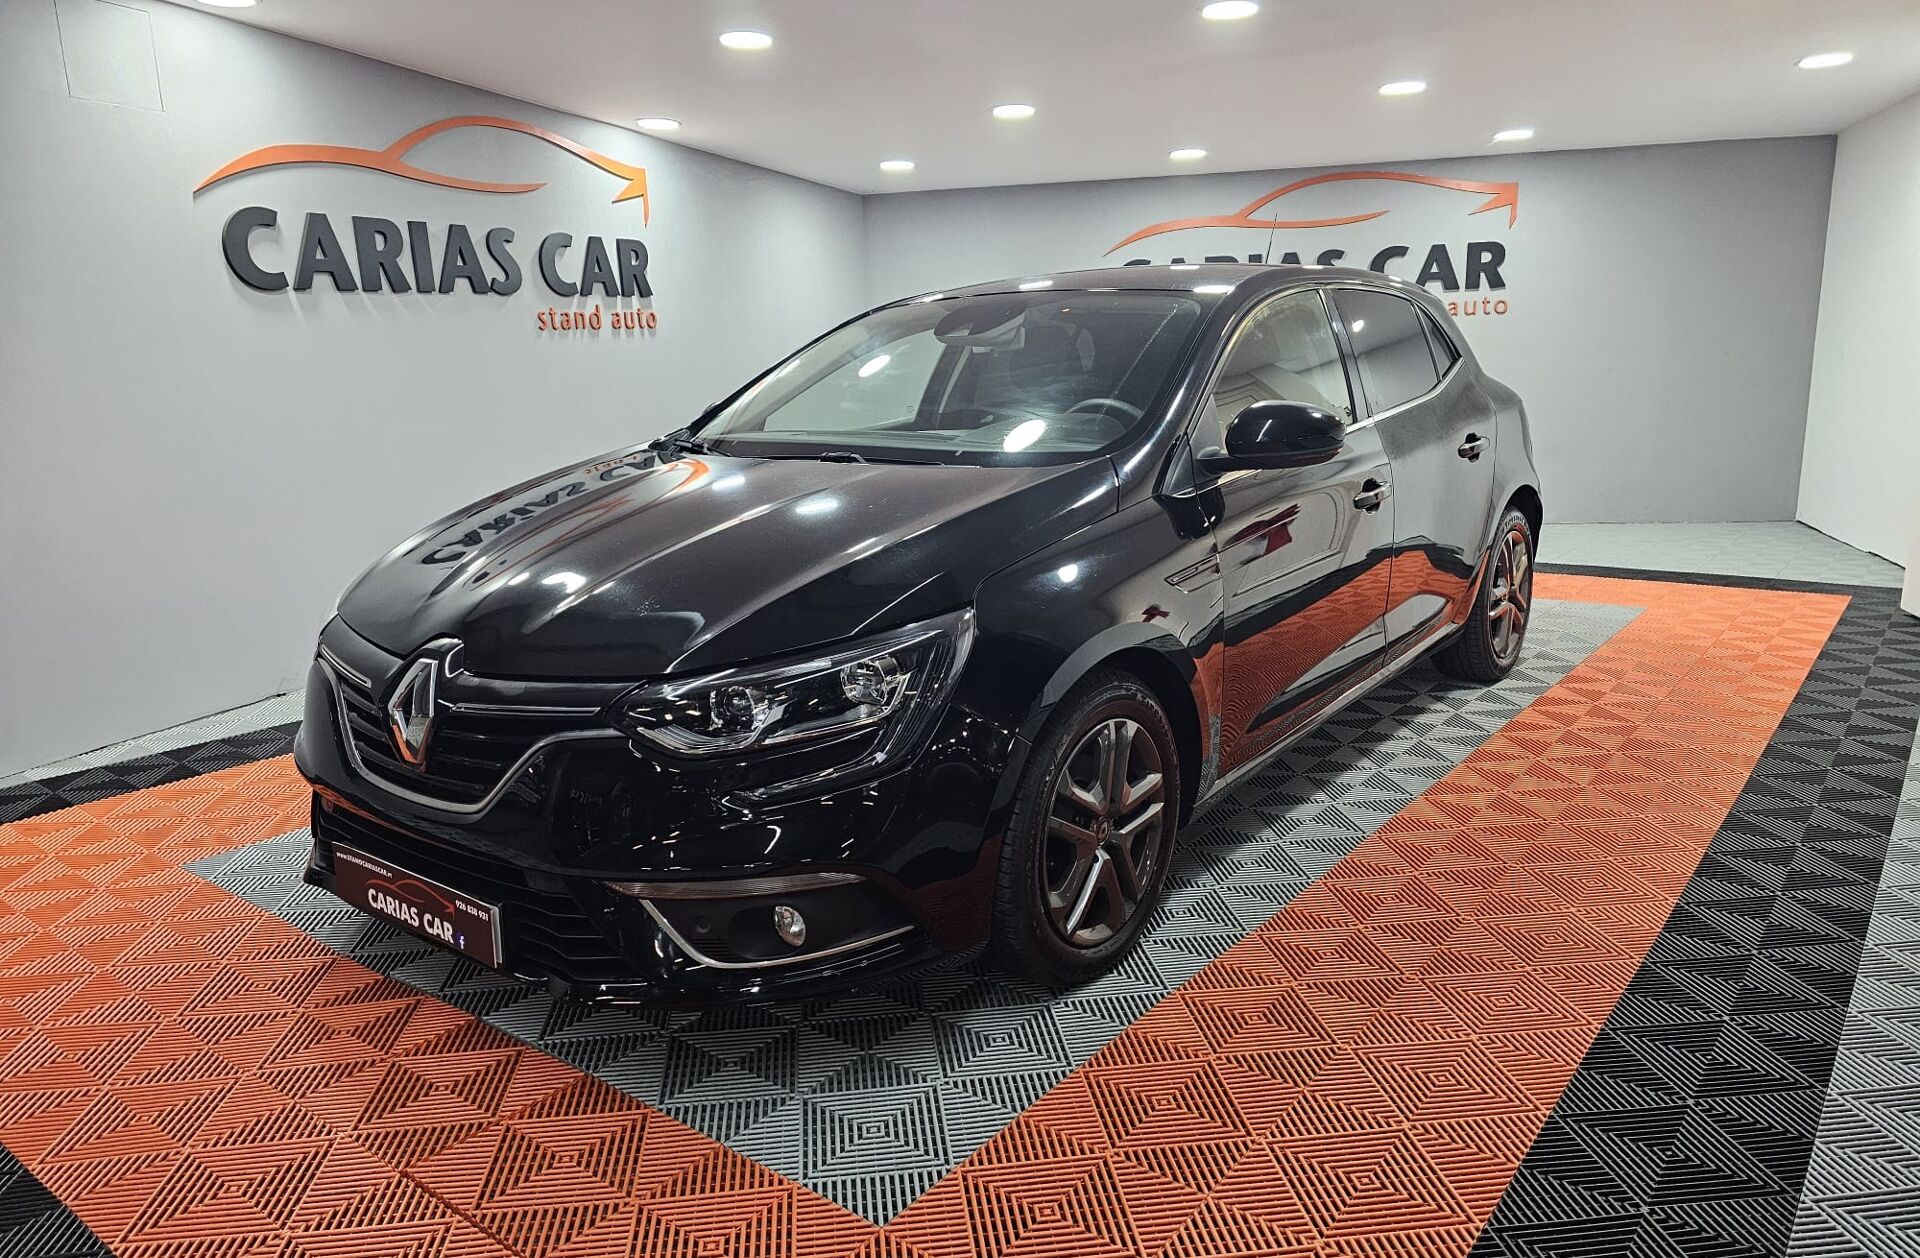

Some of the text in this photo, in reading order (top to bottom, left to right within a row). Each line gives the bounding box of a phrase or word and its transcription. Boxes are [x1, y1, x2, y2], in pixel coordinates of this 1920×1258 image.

[222, 206, 654, 298] CARIAS CAR
[1370, 241, 1506, 293] CAR
[537, 304, 657, 332] stand auto
[1447, 296, 1508, 316] auto
[368, 888, 454, 944] CARIAS CAR
